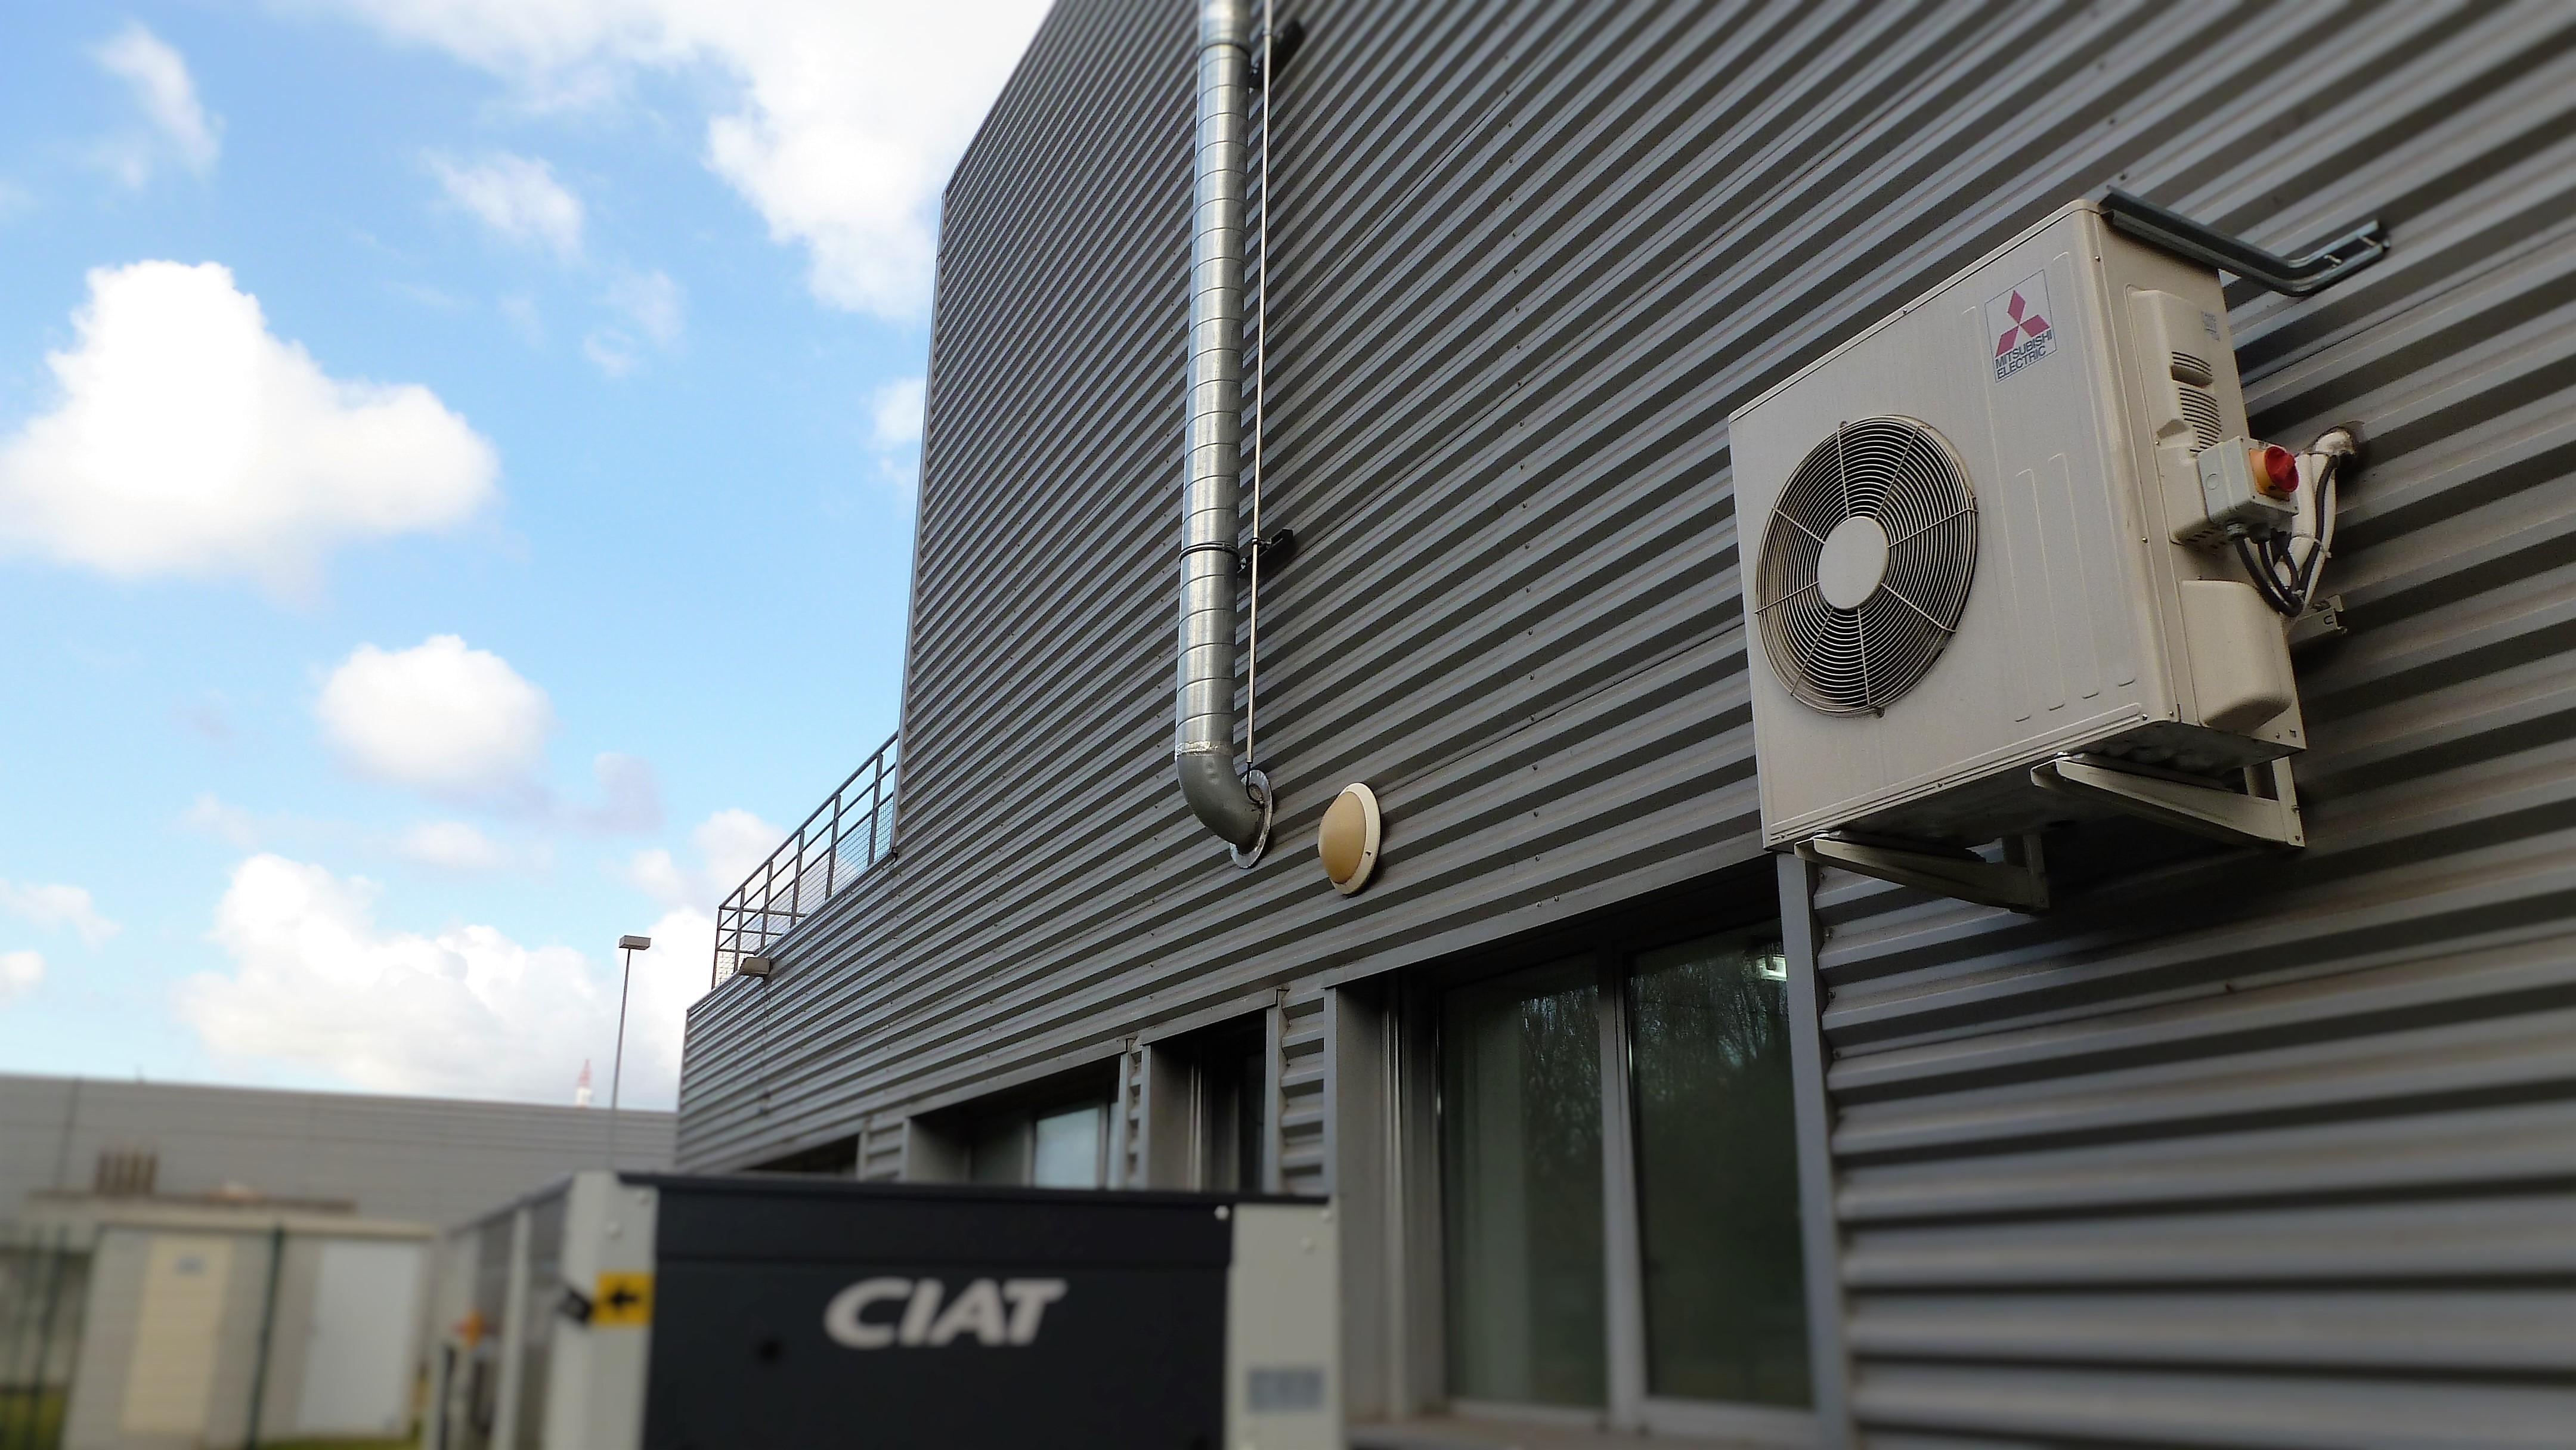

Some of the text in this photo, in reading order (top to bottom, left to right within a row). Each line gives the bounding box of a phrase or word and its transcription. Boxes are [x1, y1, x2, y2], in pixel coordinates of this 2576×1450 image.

[1996, 330, 2052, 367] MITSUBISHI
[1998, 346, 2046, 379] ELECTRIC
[824, 1276, 1068, 1350] CIAT
